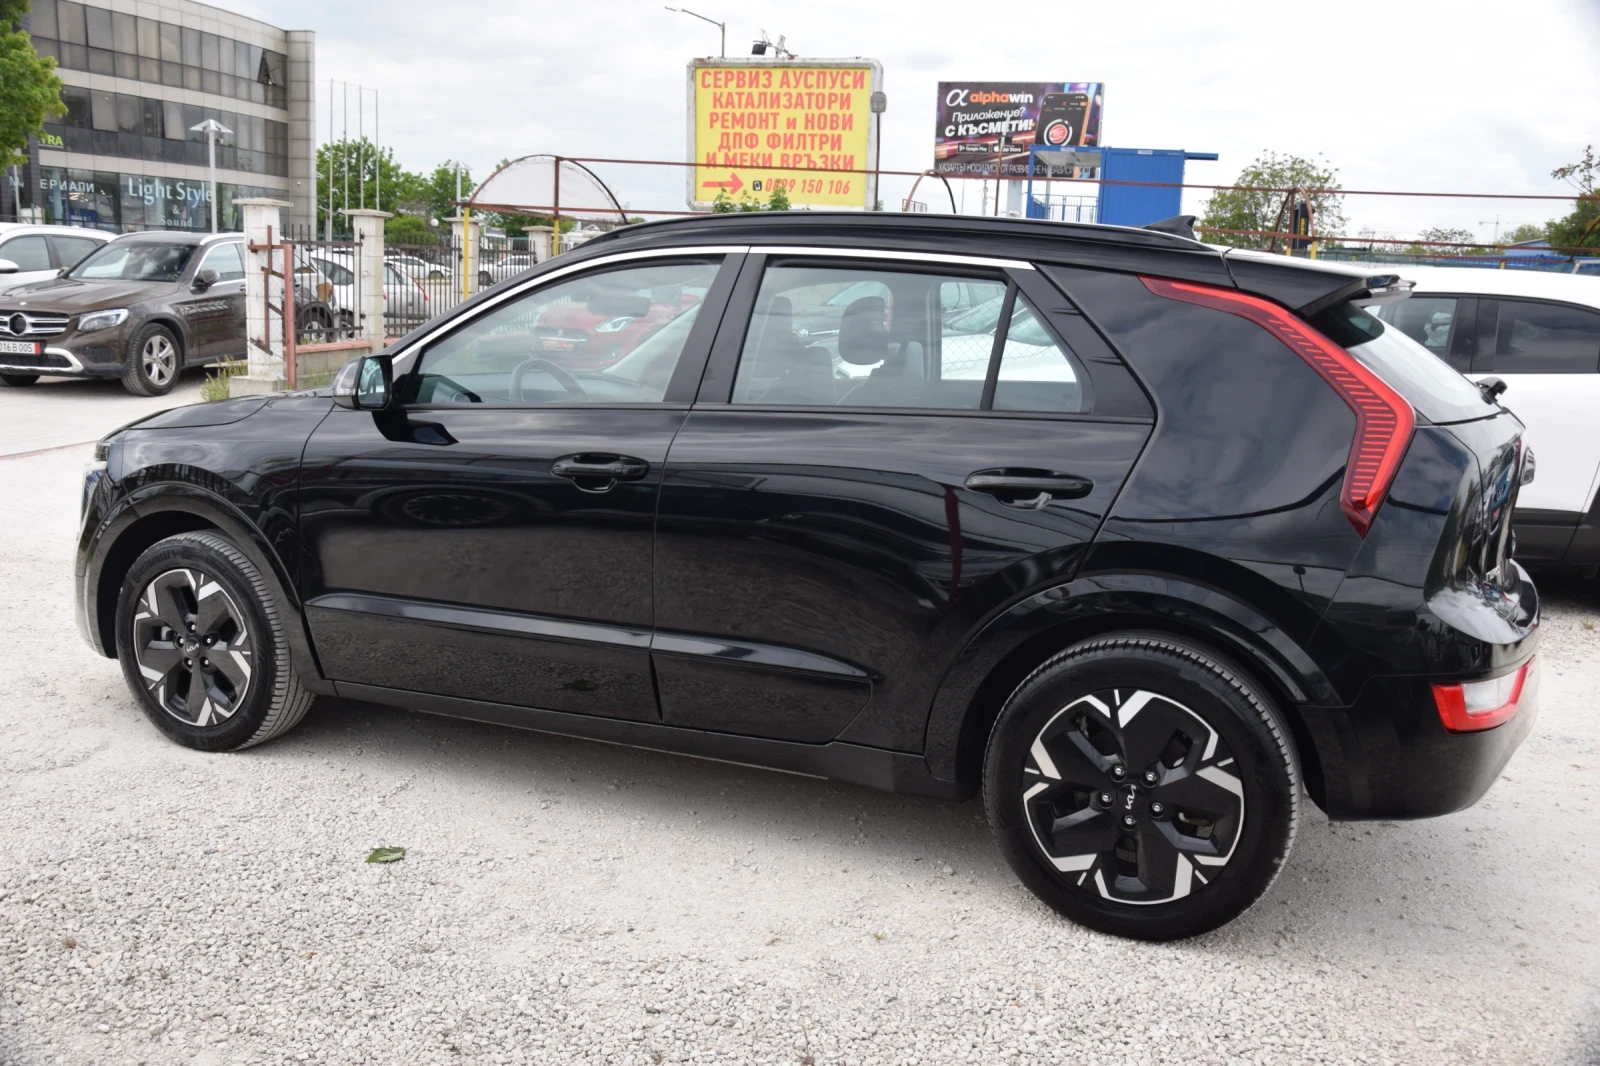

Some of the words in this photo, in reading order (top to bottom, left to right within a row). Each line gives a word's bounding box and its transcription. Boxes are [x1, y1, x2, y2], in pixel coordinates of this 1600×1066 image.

[701, 70, 773, 89] СЕРВИЗ
[779, 70, 866, 90] АУСПУСИ
[712, 91, 852, 111] КАТАЛИЗАТОРИ
[969, 90, 1034, 106] alphawin
[709, 111, 781, 130] РЕМОНТ
[786, 116, 797, 130] и
[804, 112, 854, 131] НОВИ
[718, 132, 760, 152] ДПФ
[766, 132, 843, 151] ФИЛТРИ
[706, 152, 717, 170] И
[724, 152, 773, 170] МЕКИ
[780, 153, 855, 172] ВРЪЗКИ
[128, 177, 173, 206] Light
[176, 181, 212, 208] Style
[801, 179, 823, 194] 150
[828, 180, 851, 195] 106
[160, 215, 193, 227] Sound
